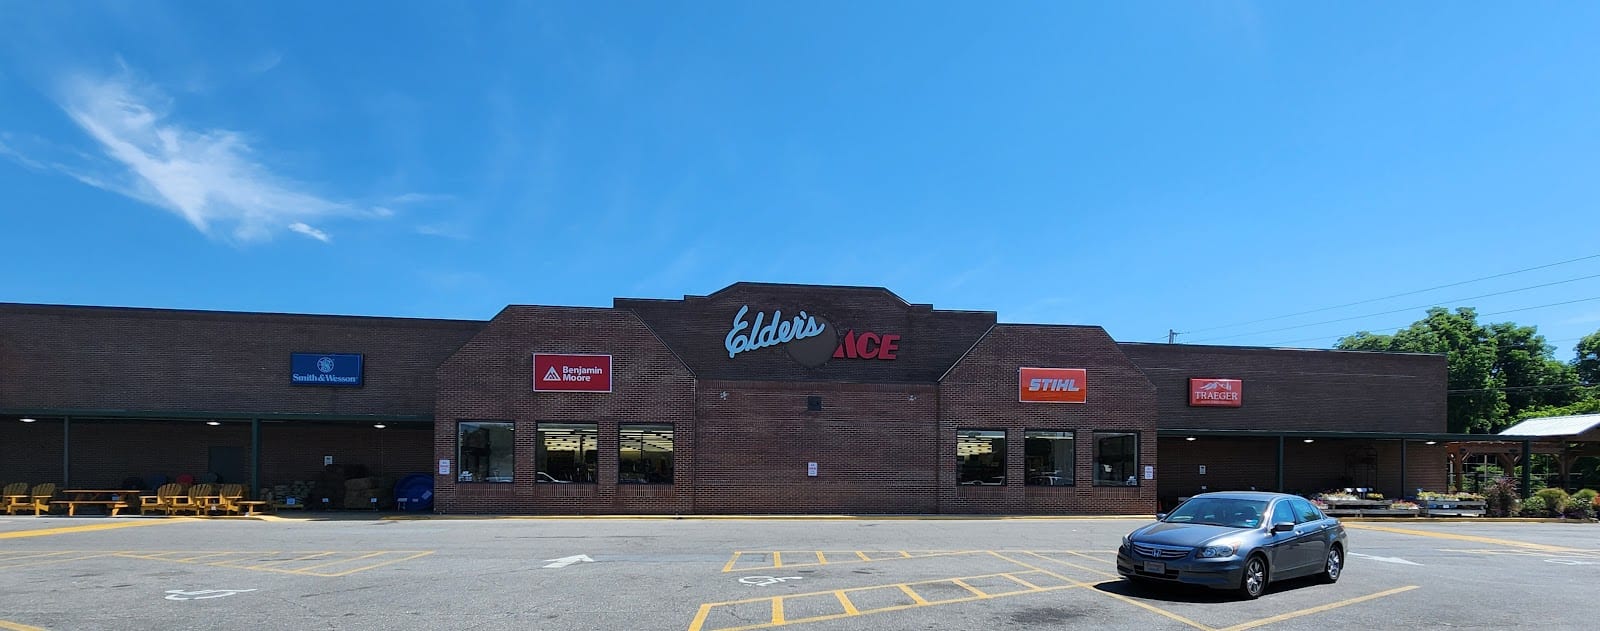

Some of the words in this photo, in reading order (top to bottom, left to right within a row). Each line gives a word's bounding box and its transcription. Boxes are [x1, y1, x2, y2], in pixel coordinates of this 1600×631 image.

[725, 305, 825, 359] Elder's
[833, 329, 901, 360] ACE
[562, 366, 603, 375] Benjamin
[562, 374, 591, 382] Moore
[1028, 378, 1080, 392] STIHL
[1194, 391, 1238, 400] TRAEGER
